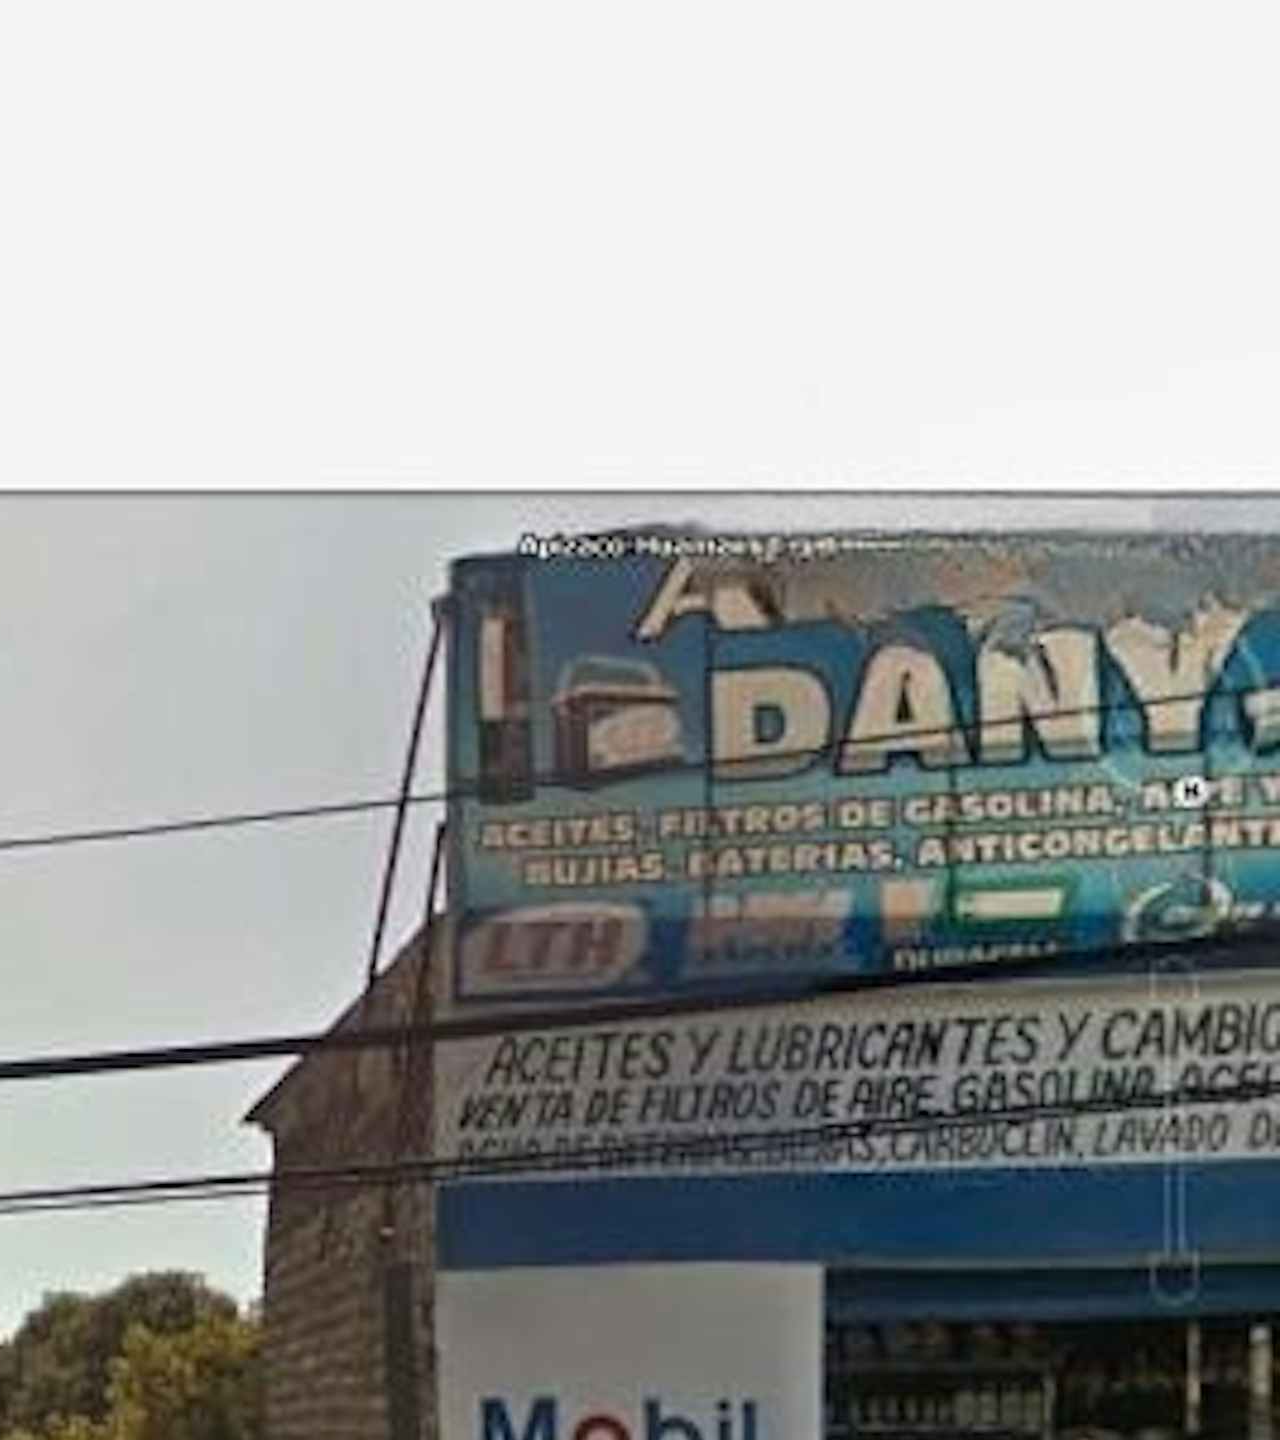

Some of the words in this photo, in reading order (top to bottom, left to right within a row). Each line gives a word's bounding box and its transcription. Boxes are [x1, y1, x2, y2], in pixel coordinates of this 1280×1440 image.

[837, 799, 893, 830] DE
[483, 920, 624, 974] LTH
[485, 1032, 675, 1085] ACEITES
[689, 1029, 720, 1075] Y
[726, 1016, 1040, 1076] LUBRICANTES
[1057, 1011, 1093, 1062] Y
[457, 1088, 573, 1131] VENTA
[584, 1086, 627, 1128] DE
[639, 1078, 782, 1124] FILTROS
[794, 1078, 843, 1119] DE
[1094, 1111, 1231, 1155] LAVADO
[1248, 1108, 1280, 1151] D
